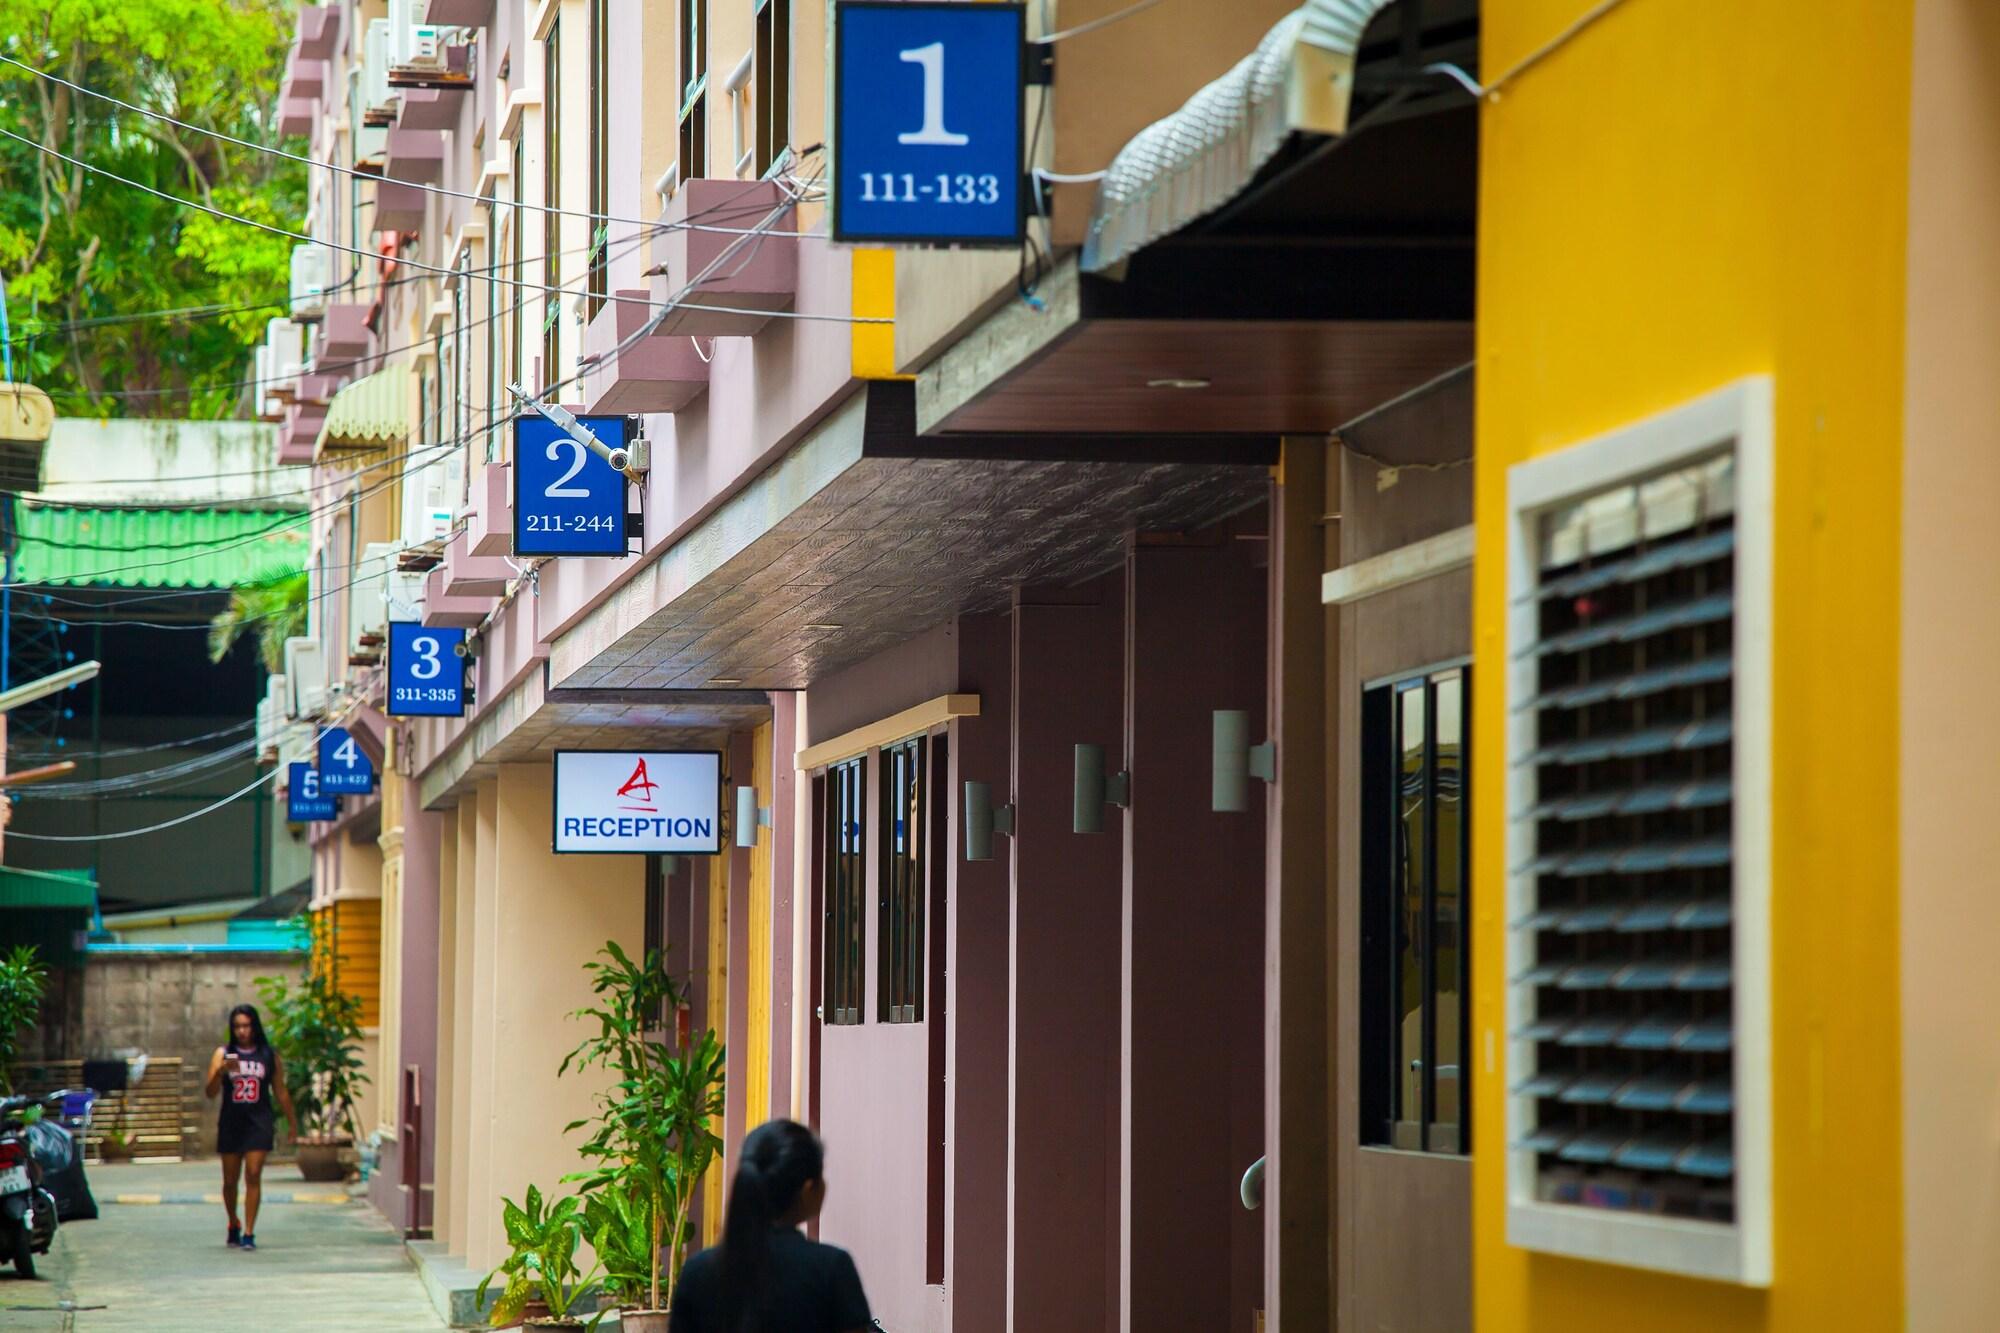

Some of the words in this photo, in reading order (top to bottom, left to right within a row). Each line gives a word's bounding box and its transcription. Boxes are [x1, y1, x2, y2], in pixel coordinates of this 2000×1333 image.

[898, 41, 969, 146] 1
[859, 172, 1000, 204] 111-133
[544, 438, 590, 498] 2
[526, 514, 615, 533] 211-244
[410, 636, 441, 679] 3
[395, 687, 457, 702] 311-335
[332, 737, 359, 769] 4
[302, 770, 319, 799] 5
[564, 817, 711, 838] RECEPTION
[232, 1076, 260, 1104] 23
